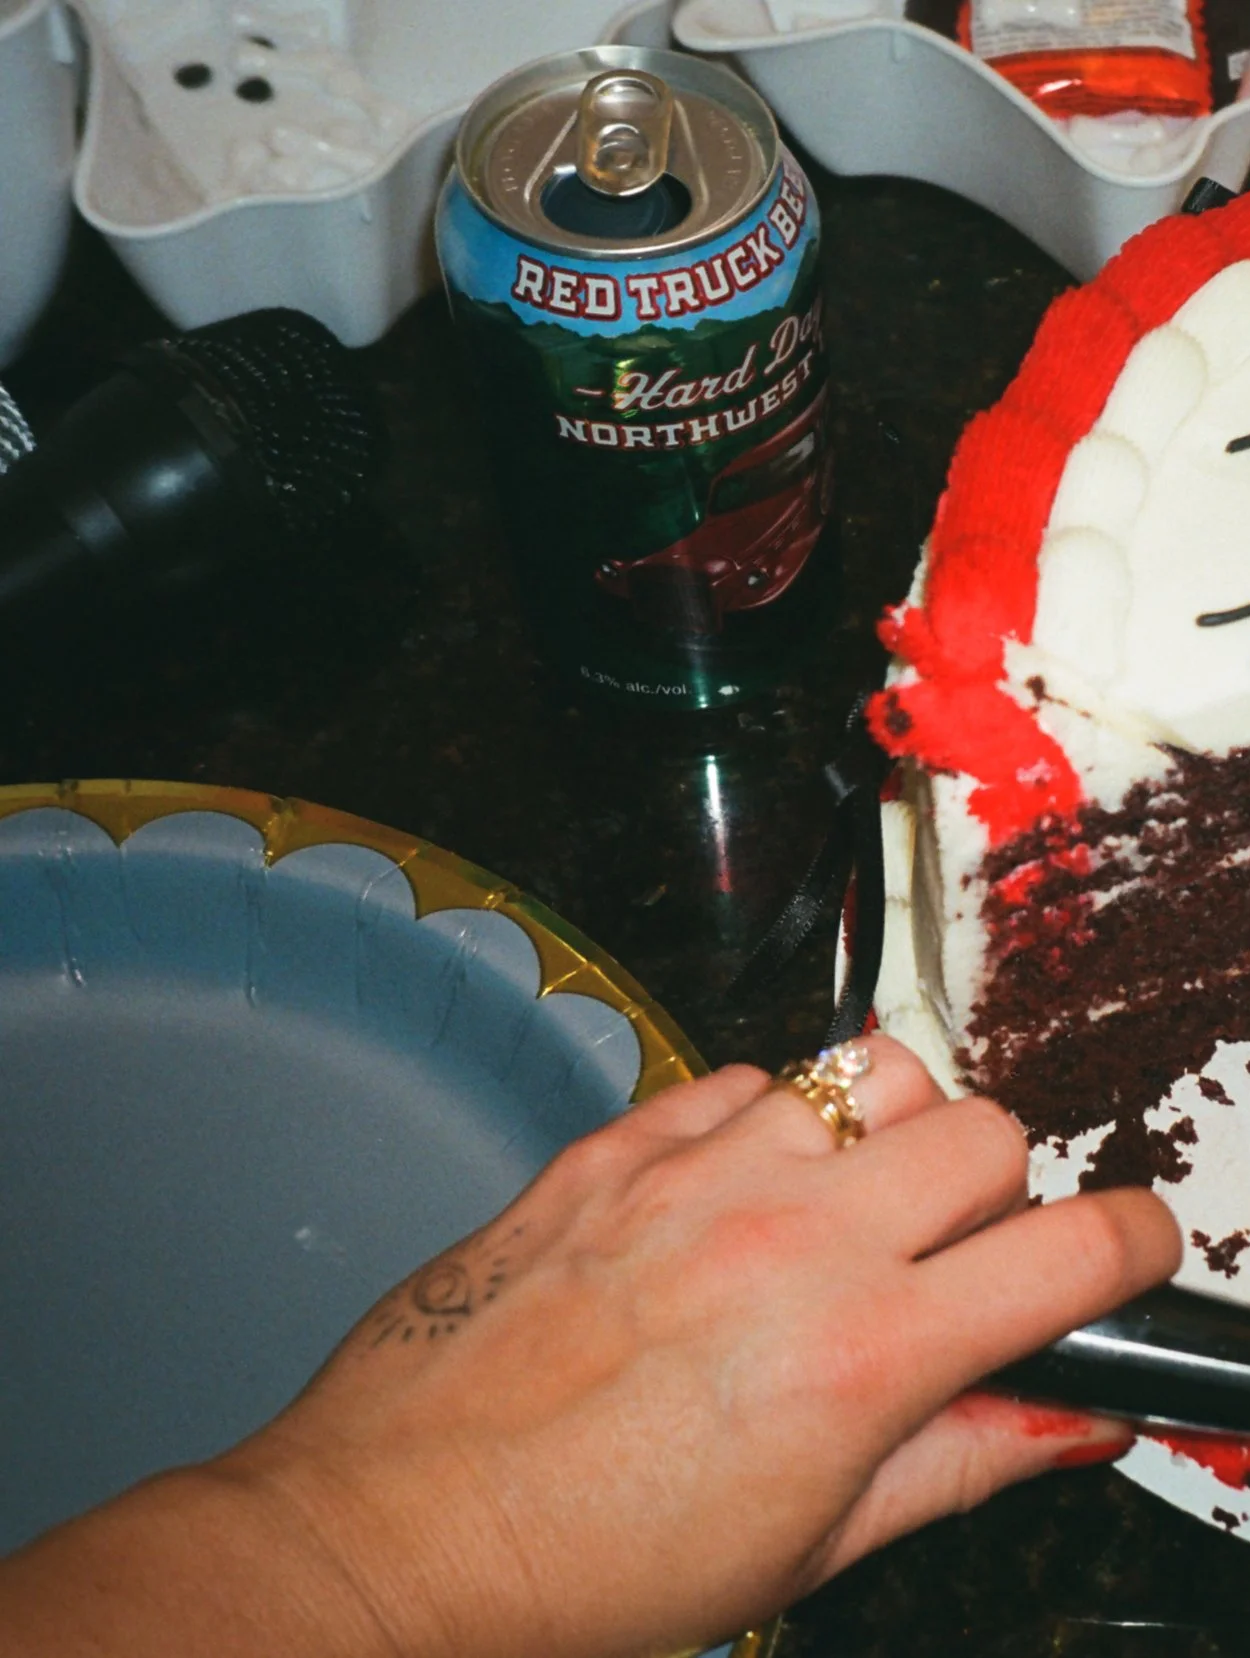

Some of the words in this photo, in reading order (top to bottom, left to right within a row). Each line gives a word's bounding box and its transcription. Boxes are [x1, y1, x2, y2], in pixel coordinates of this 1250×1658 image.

[511, 255, 621, 321] RED
[626, 225, 785, 321] TRUCK
[555, 348, 815, 449] NORTHWEST
[611, 344, 757, 411] Hard
